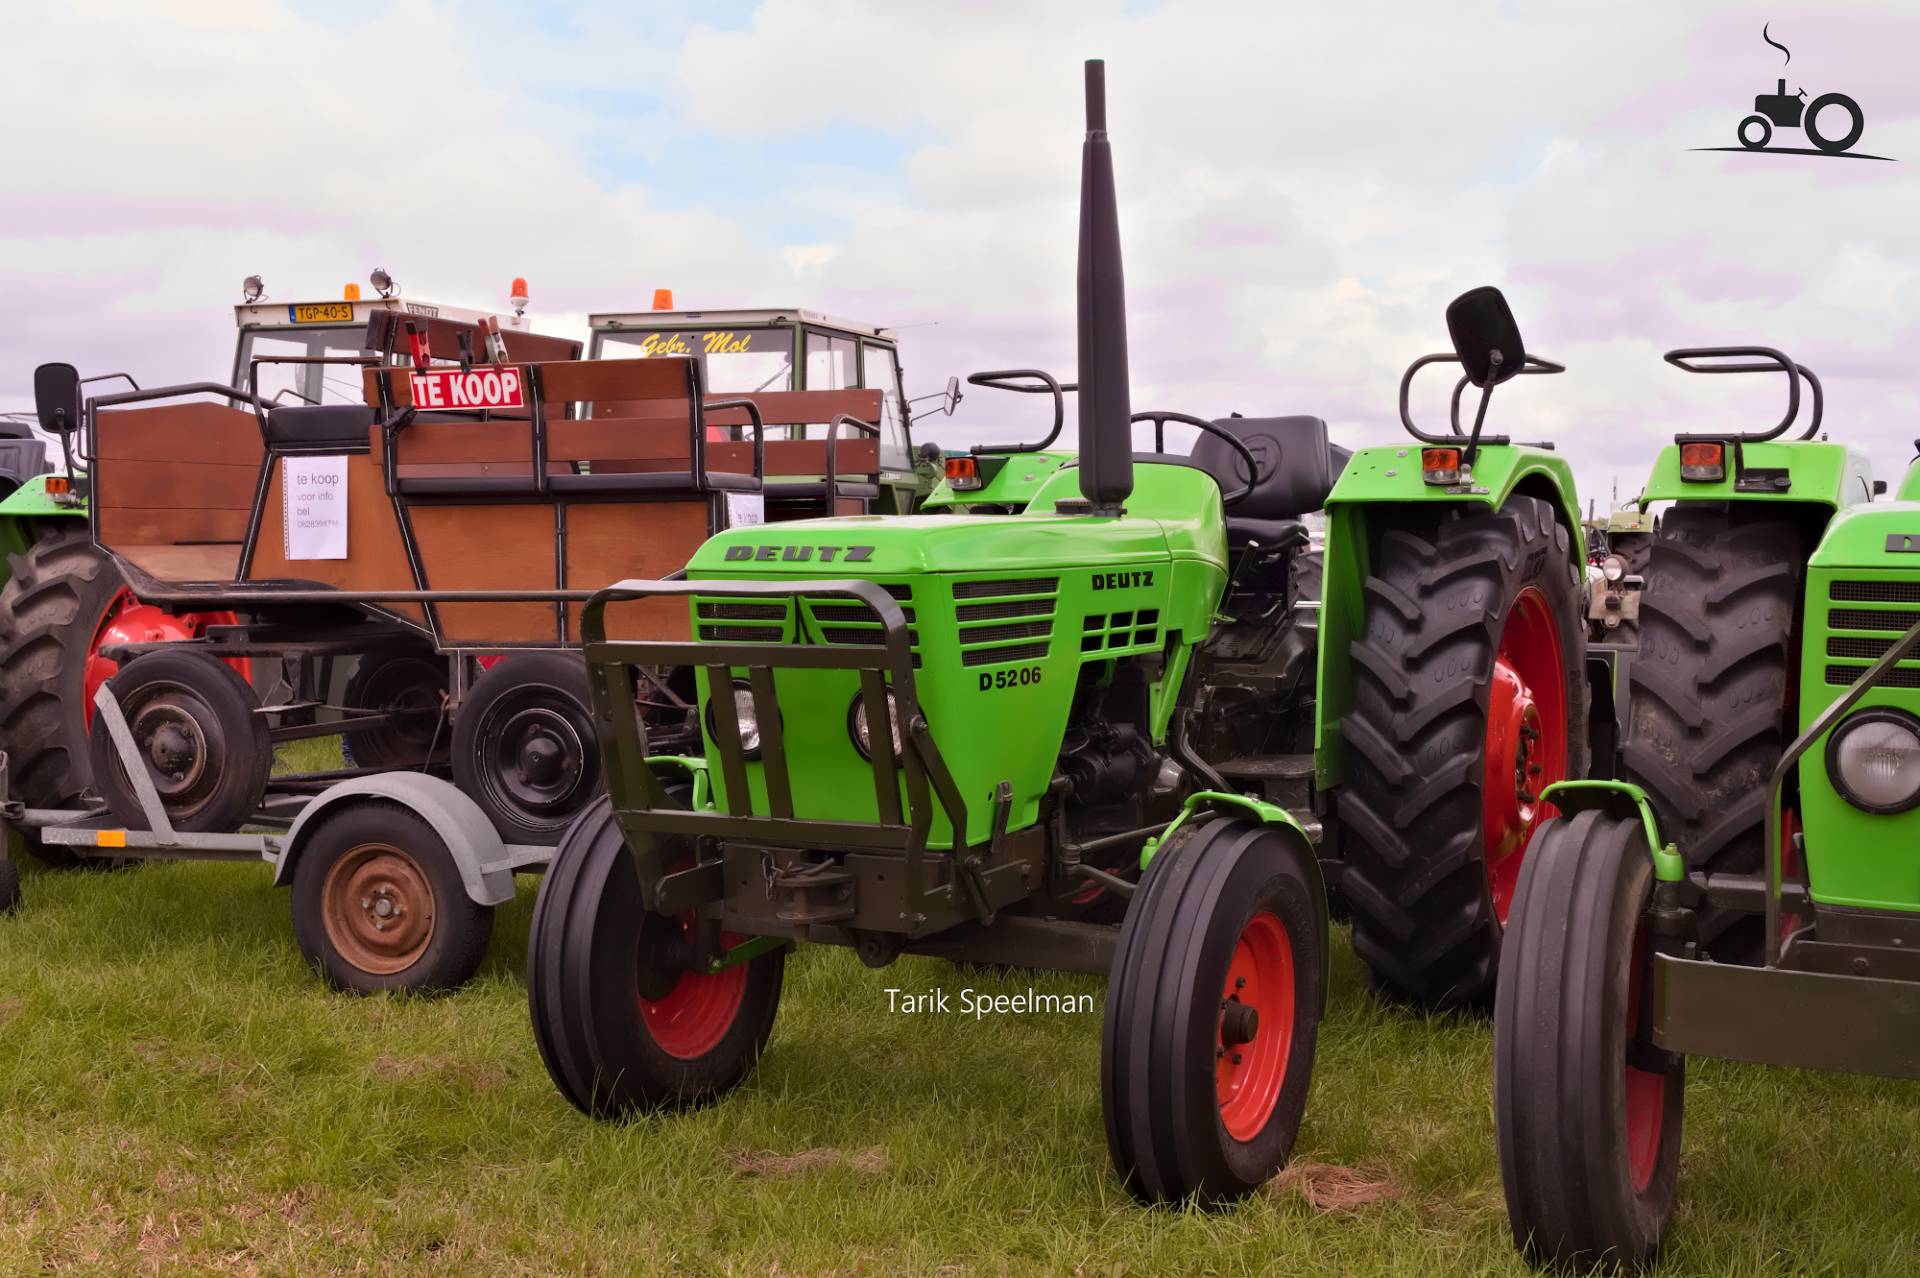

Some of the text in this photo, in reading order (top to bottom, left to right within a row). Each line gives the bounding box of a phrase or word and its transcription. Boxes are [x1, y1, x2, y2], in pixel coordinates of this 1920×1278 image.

[299, 306, 349, 320] TGP-40-S
[640, 331, 752, 359] Gebr. Mol
[412, 372, 518, 406] TE KOOP
[297, 472, 340, 487] te koop
[724, 545, 876, 563] DEUTZ
[1091, 570, 1154, 591] DEUTZ
[979, 666, 1041, 692] D 5206
